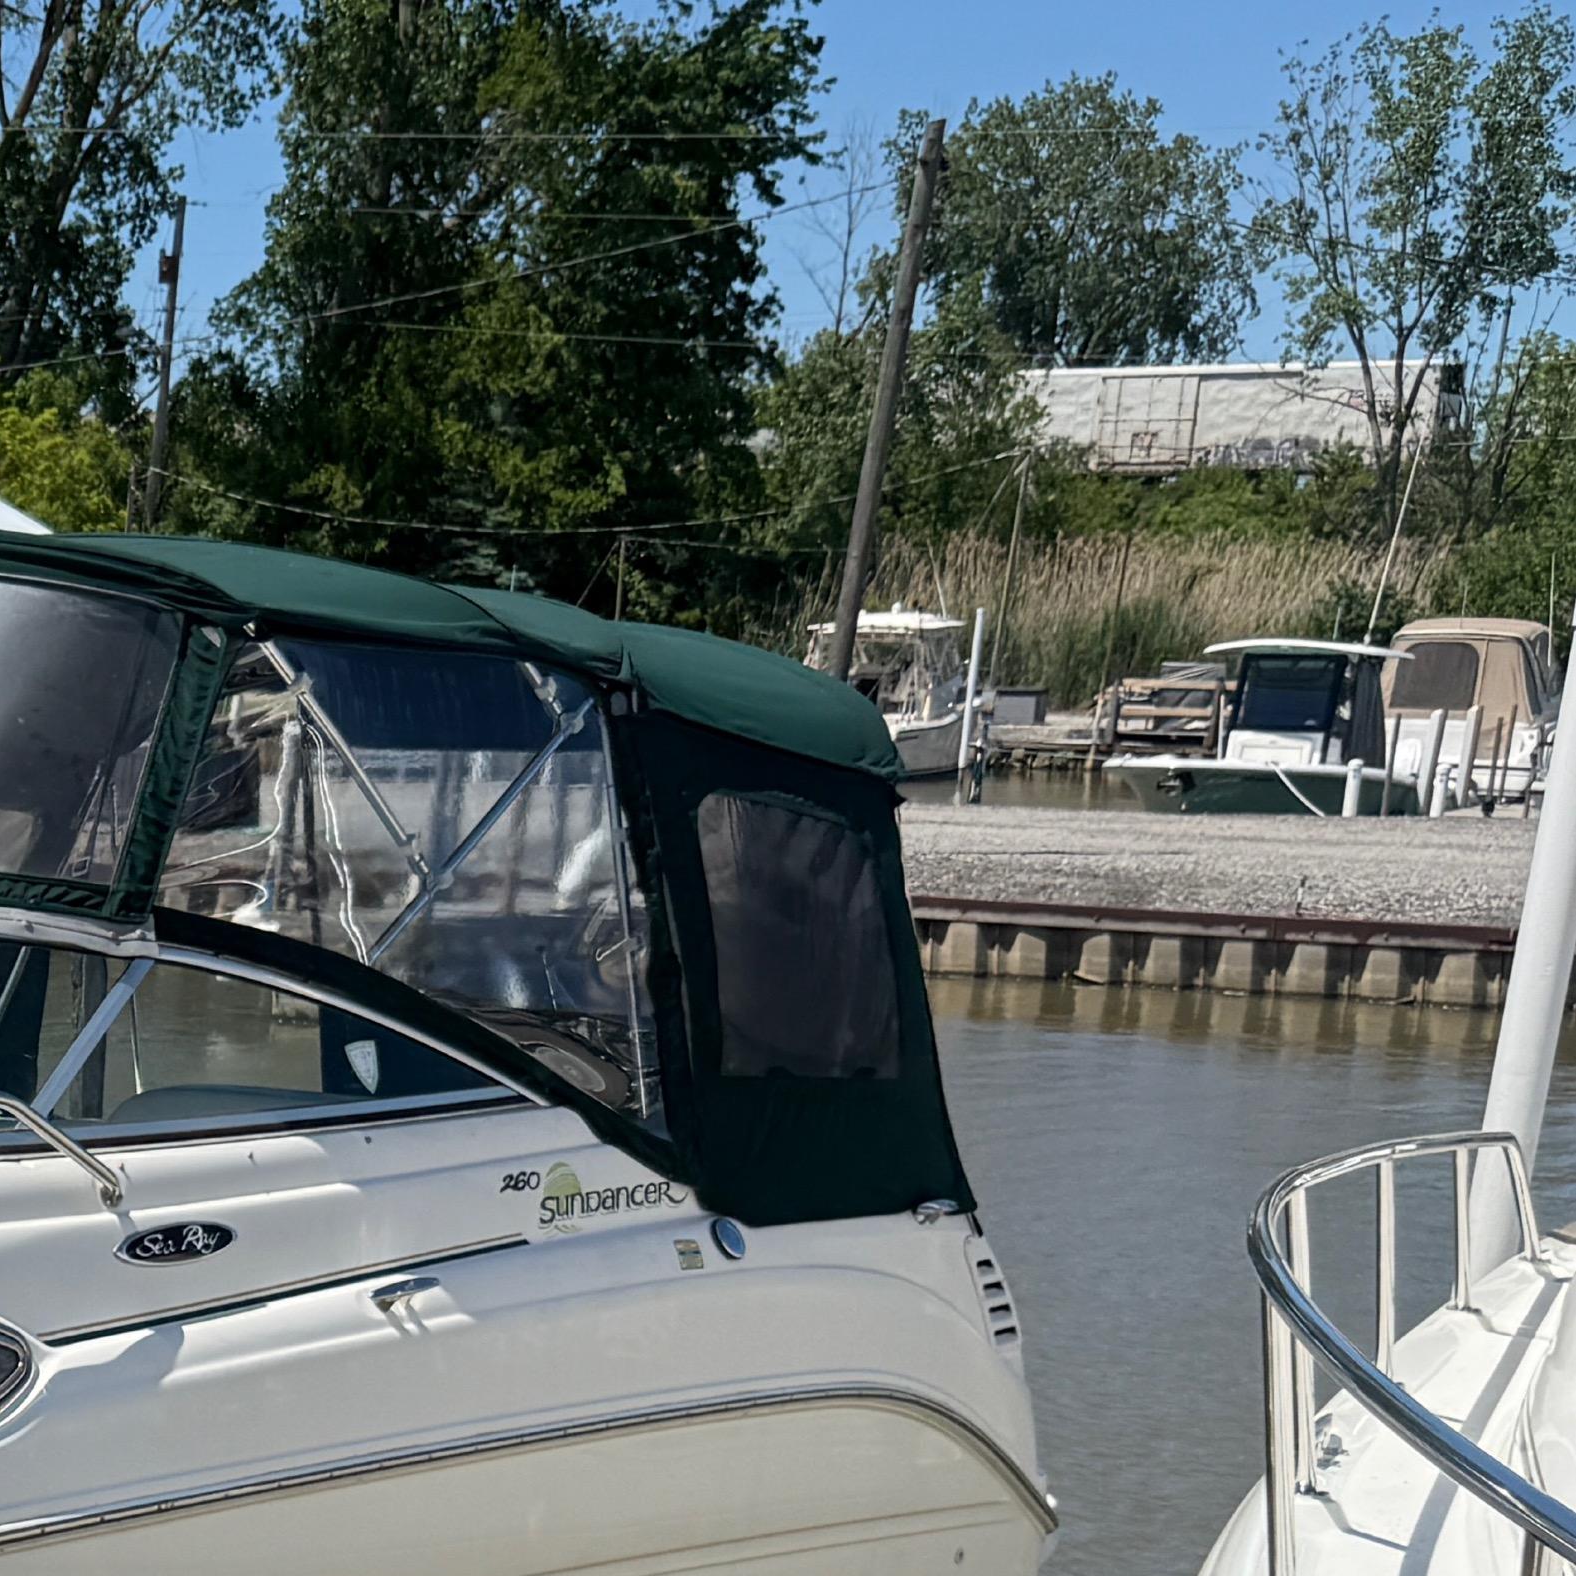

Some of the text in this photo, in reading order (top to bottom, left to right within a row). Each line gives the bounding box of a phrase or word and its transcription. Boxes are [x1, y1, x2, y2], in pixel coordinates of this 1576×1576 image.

[500, 1171, 541, 1193] 260
[135, 1224, 220, 1257] Sea Ray
